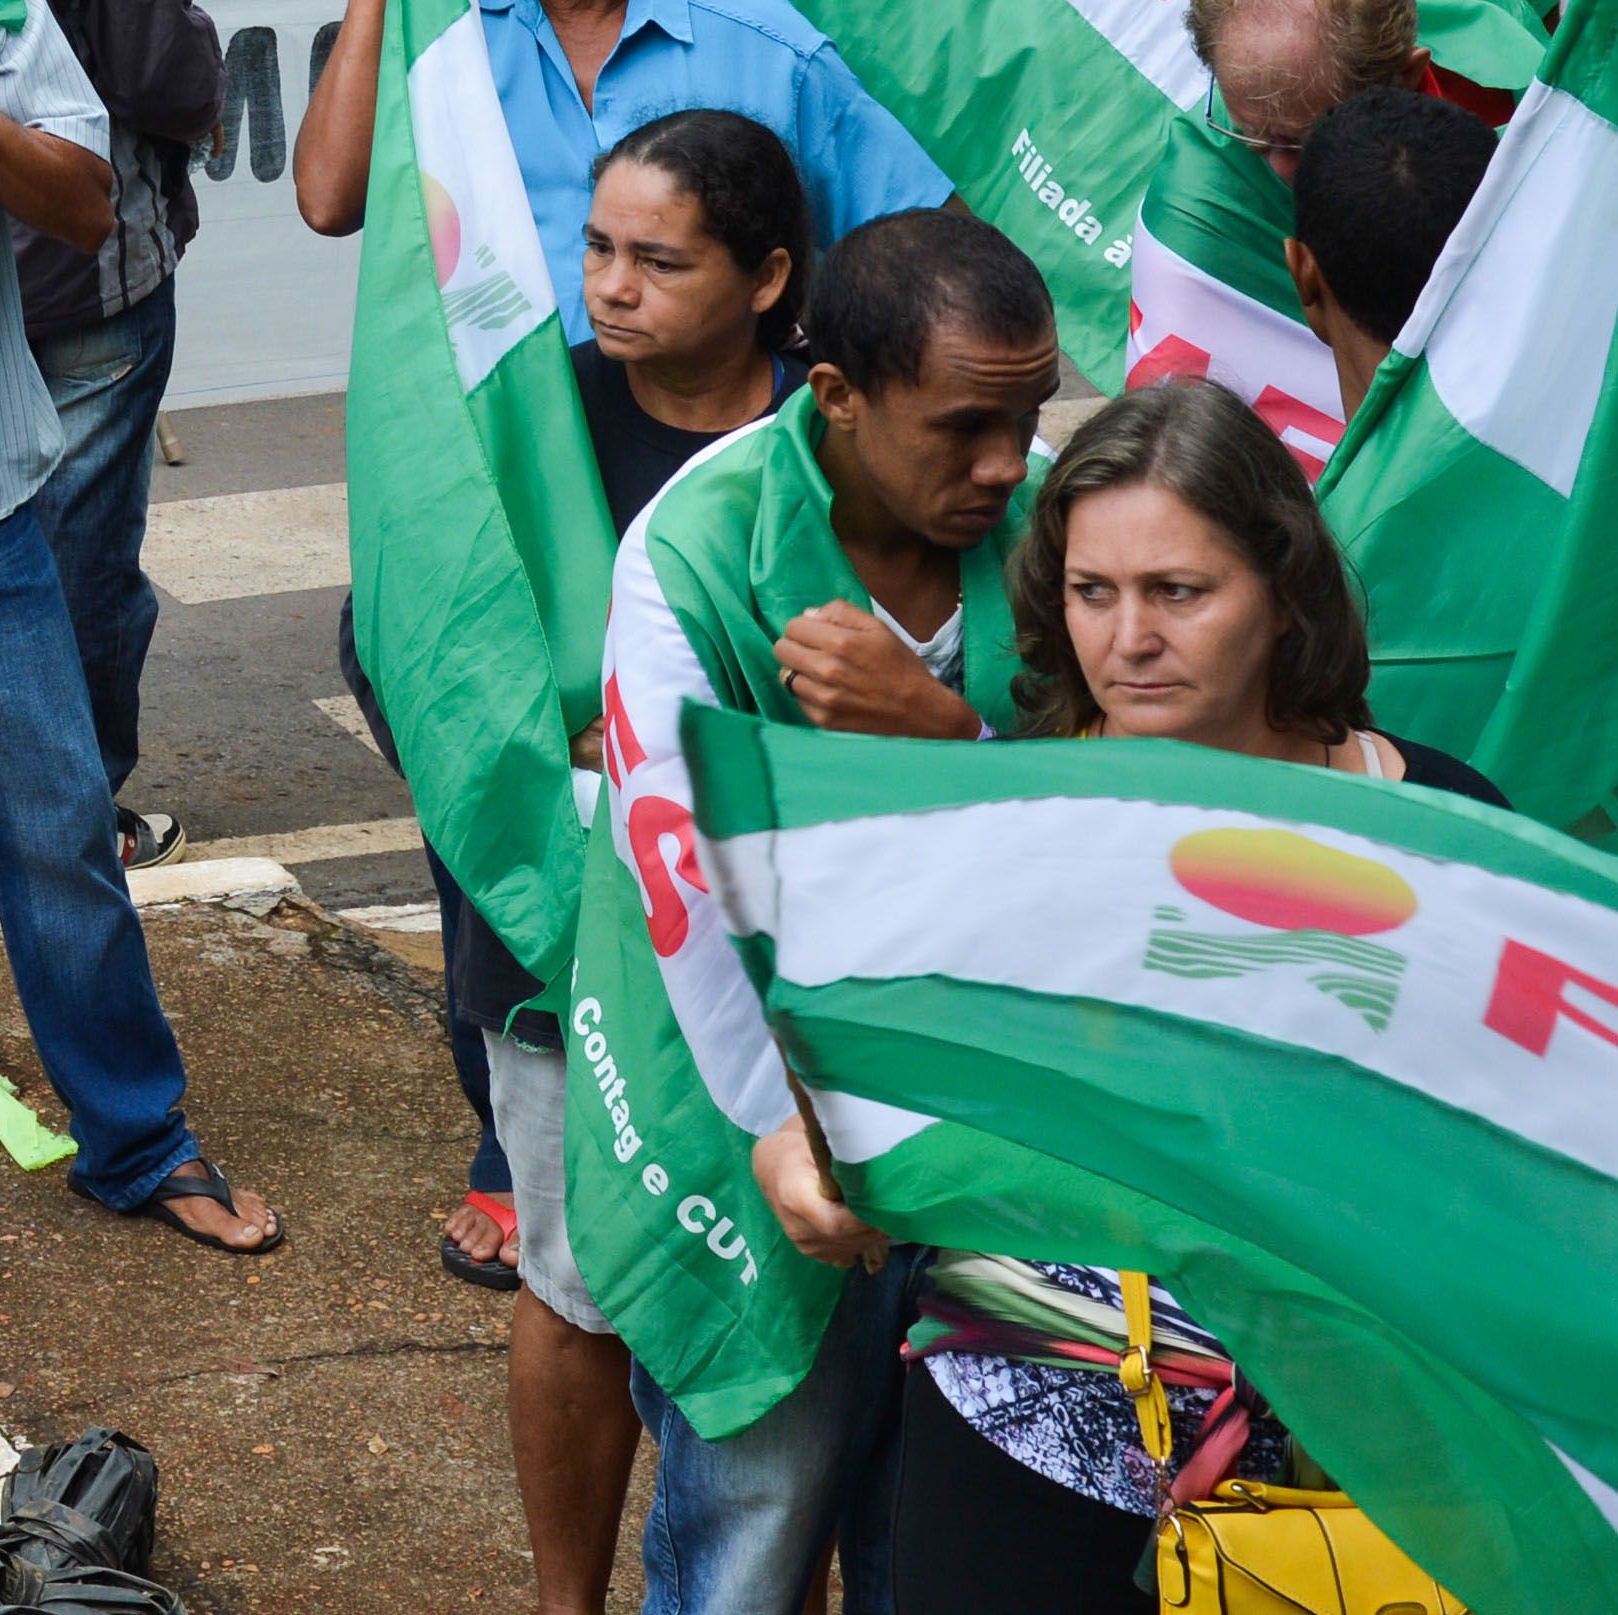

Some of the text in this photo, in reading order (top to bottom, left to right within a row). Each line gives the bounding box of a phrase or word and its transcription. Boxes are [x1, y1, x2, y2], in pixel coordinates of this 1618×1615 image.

[1011, 127, 1103, 246] Filiada
[573, 997, 758, 1287] Contag e CUT
